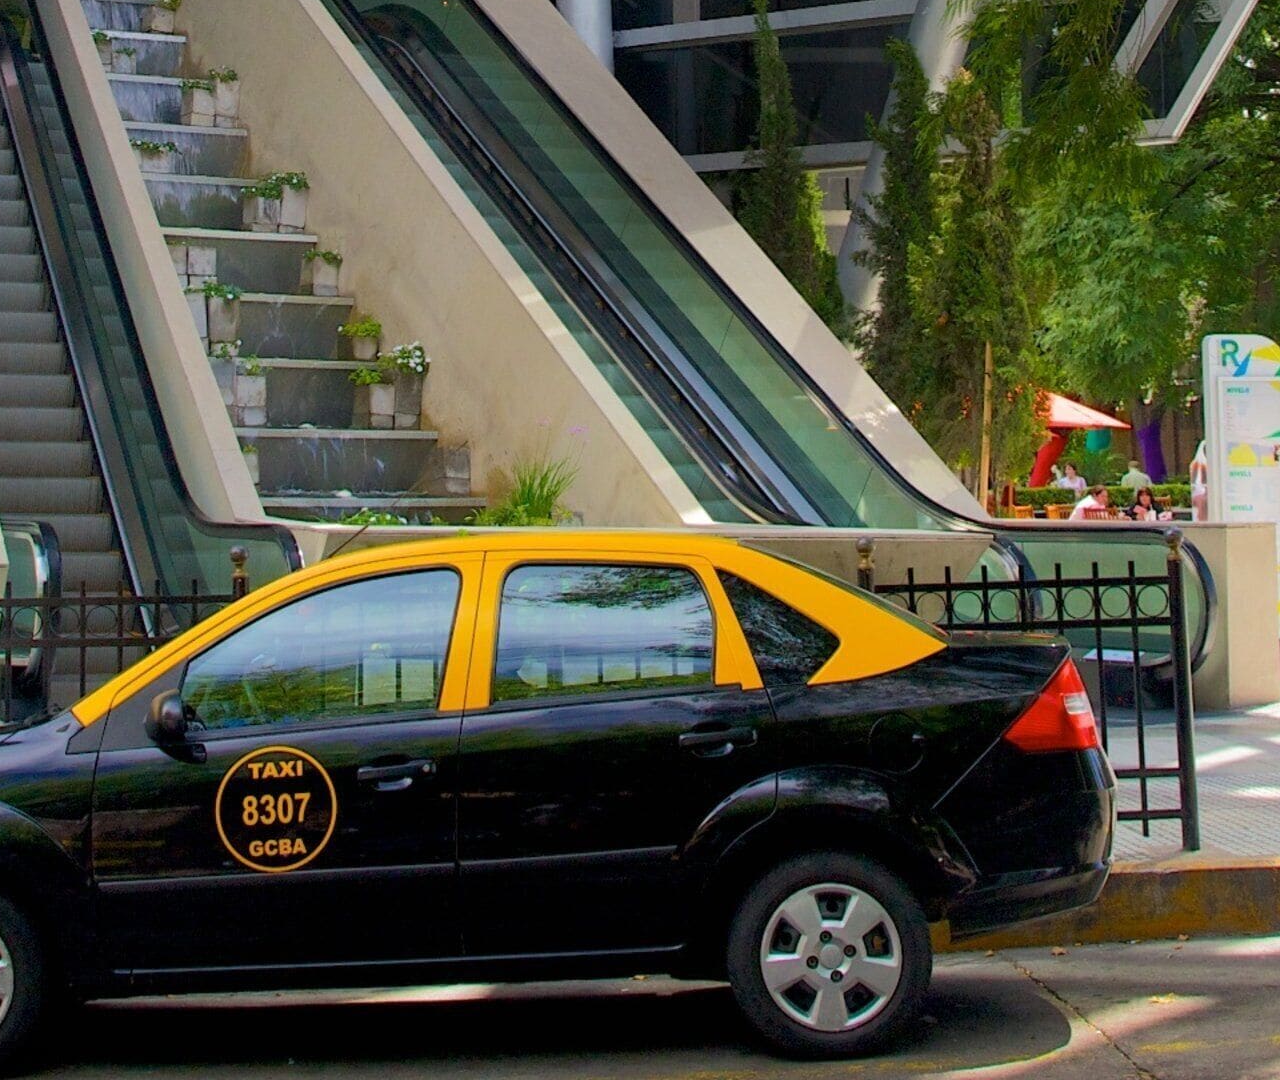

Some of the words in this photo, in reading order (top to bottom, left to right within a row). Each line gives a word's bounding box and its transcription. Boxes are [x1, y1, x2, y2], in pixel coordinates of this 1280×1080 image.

[248, 760, 304, 779] TAXI
[242, 792, 311, 826] 8307
[248, 838, 307, 857] GCBA
